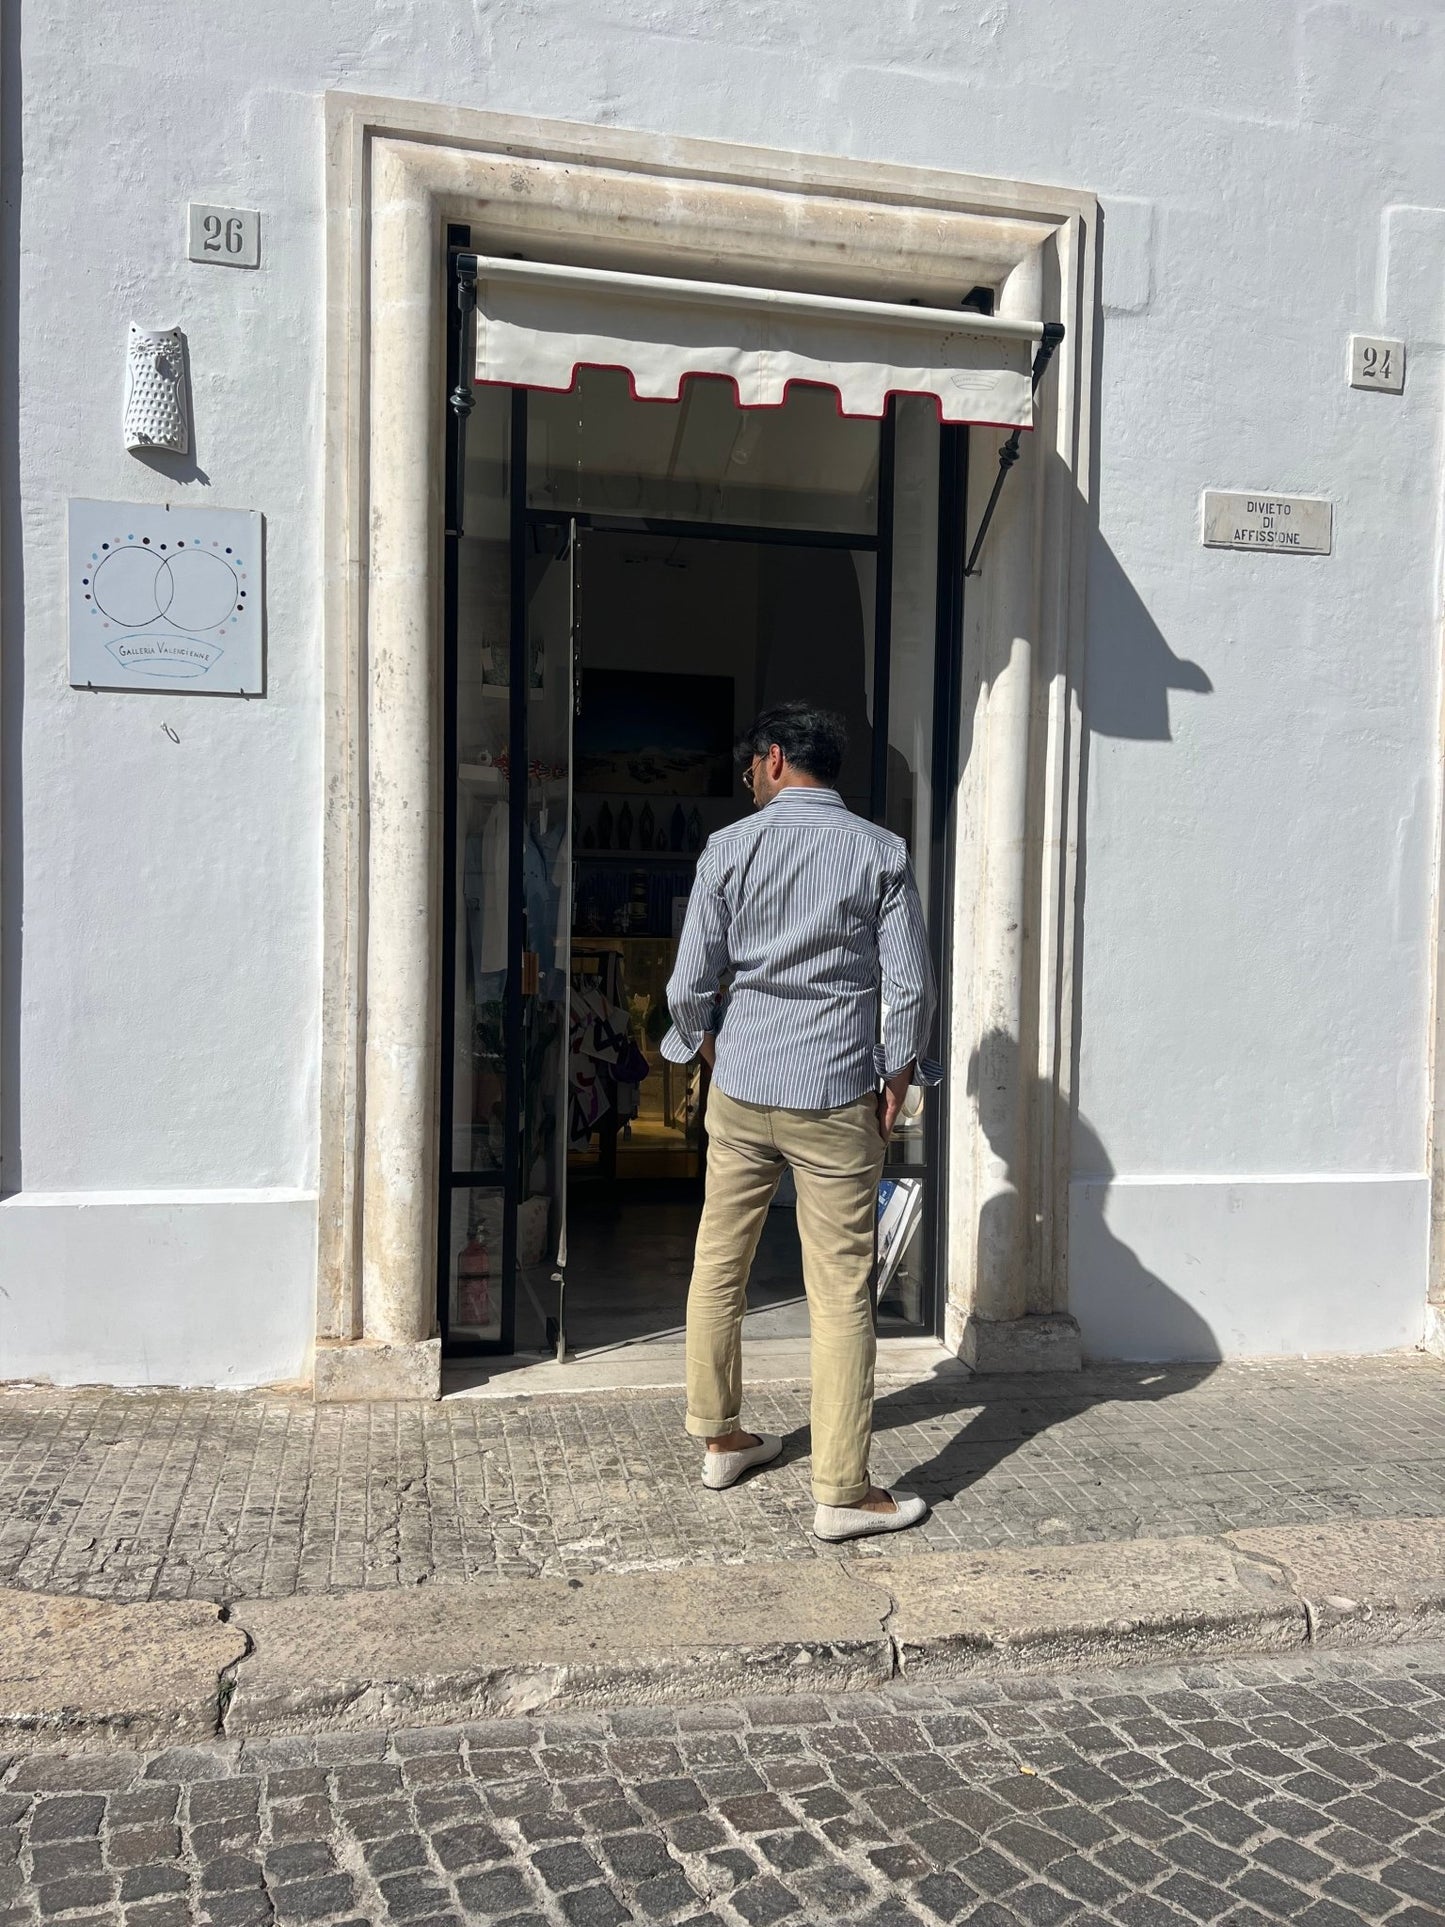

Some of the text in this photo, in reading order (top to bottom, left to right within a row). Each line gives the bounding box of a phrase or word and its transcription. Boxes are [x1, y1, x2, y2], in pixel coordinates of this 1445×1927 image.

[204, 215, 243, 254] 26
[1362, 347, 1392, 379] 24
[1247, 501, 1291, 515] DIVIETO
[1263, 517, 1274, 528] DI
[1234, 529, 1300, 544] AFFISSIONE
